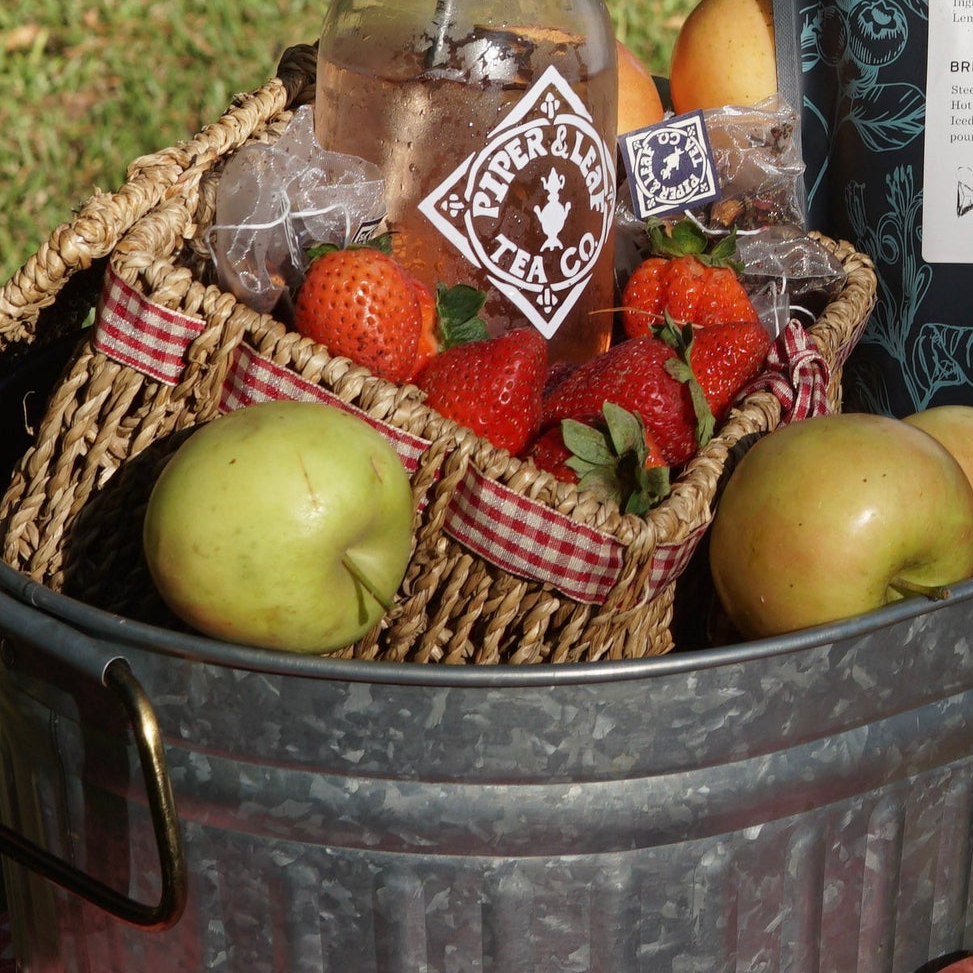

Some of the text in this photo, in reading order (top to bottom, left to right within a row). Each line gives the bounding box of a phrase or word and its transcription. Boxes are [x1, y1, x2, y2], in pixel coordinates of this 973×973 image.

[472, 127, 548, 218] PIPER
[684, 137, 703, 168] TEA
[660, 174, 700, 200] PIPER
[490, 233, 548, 284] TEA
